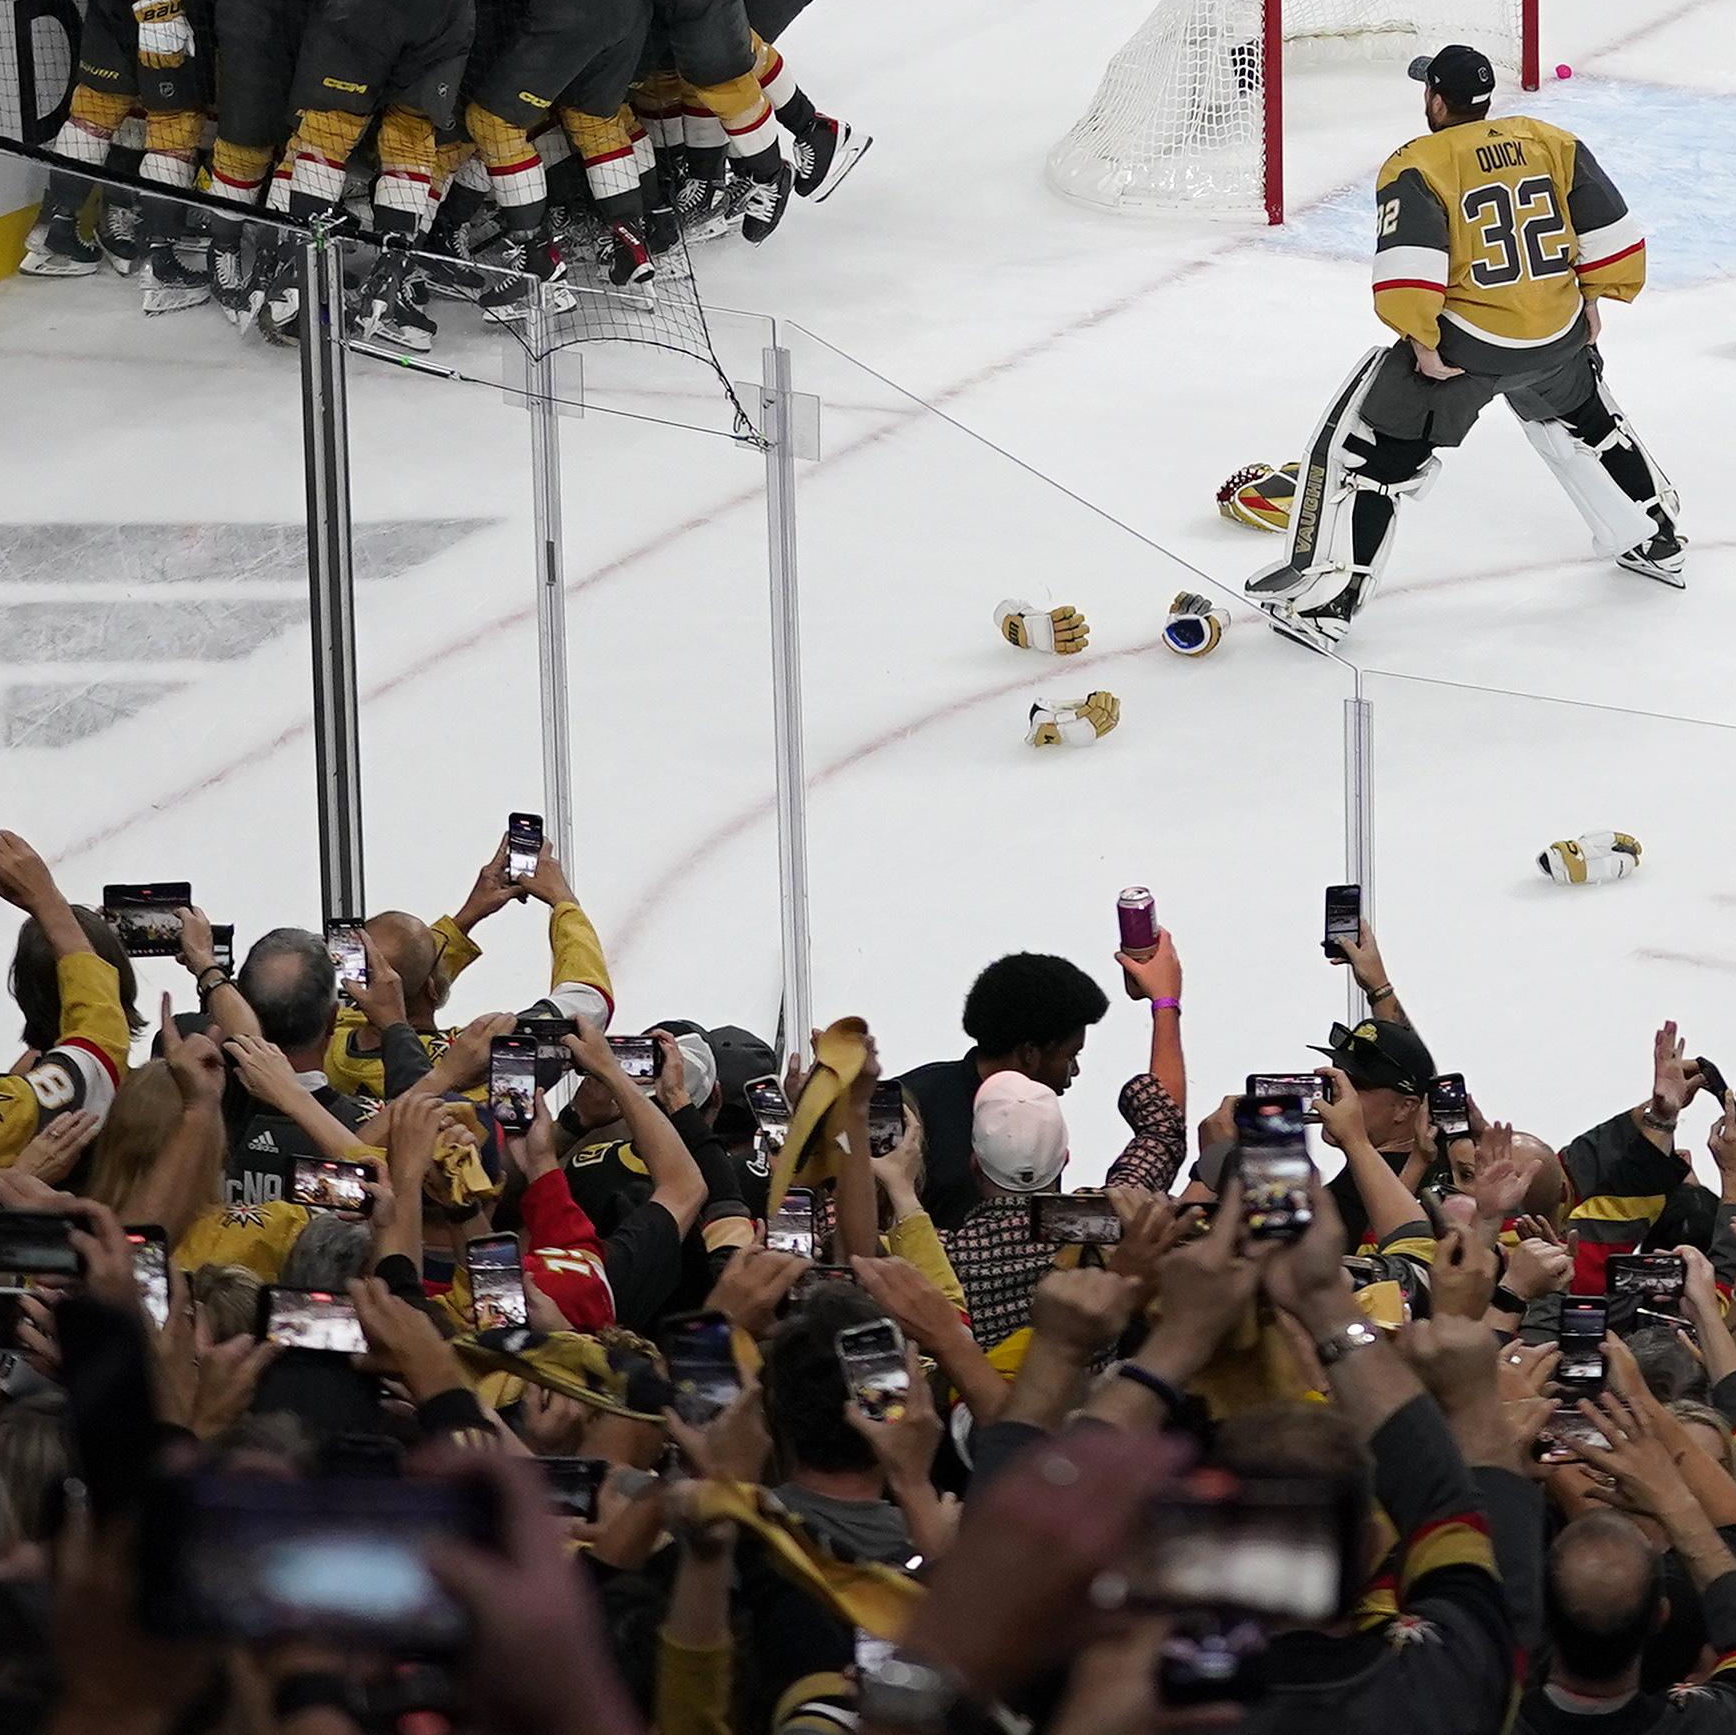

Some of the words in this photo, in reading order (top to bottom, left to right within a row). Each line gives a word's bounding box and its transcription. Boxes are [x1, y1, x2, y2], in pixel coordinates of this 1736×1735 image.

[321, 76, 369, 95] CCM
[1475, 140, 1527, 173] QUICK
[1460, 173, 1571, 290] 32
[1295, 464, 1326, 554] VAUGHN
[247, 1141, 280, 1156] adidas
